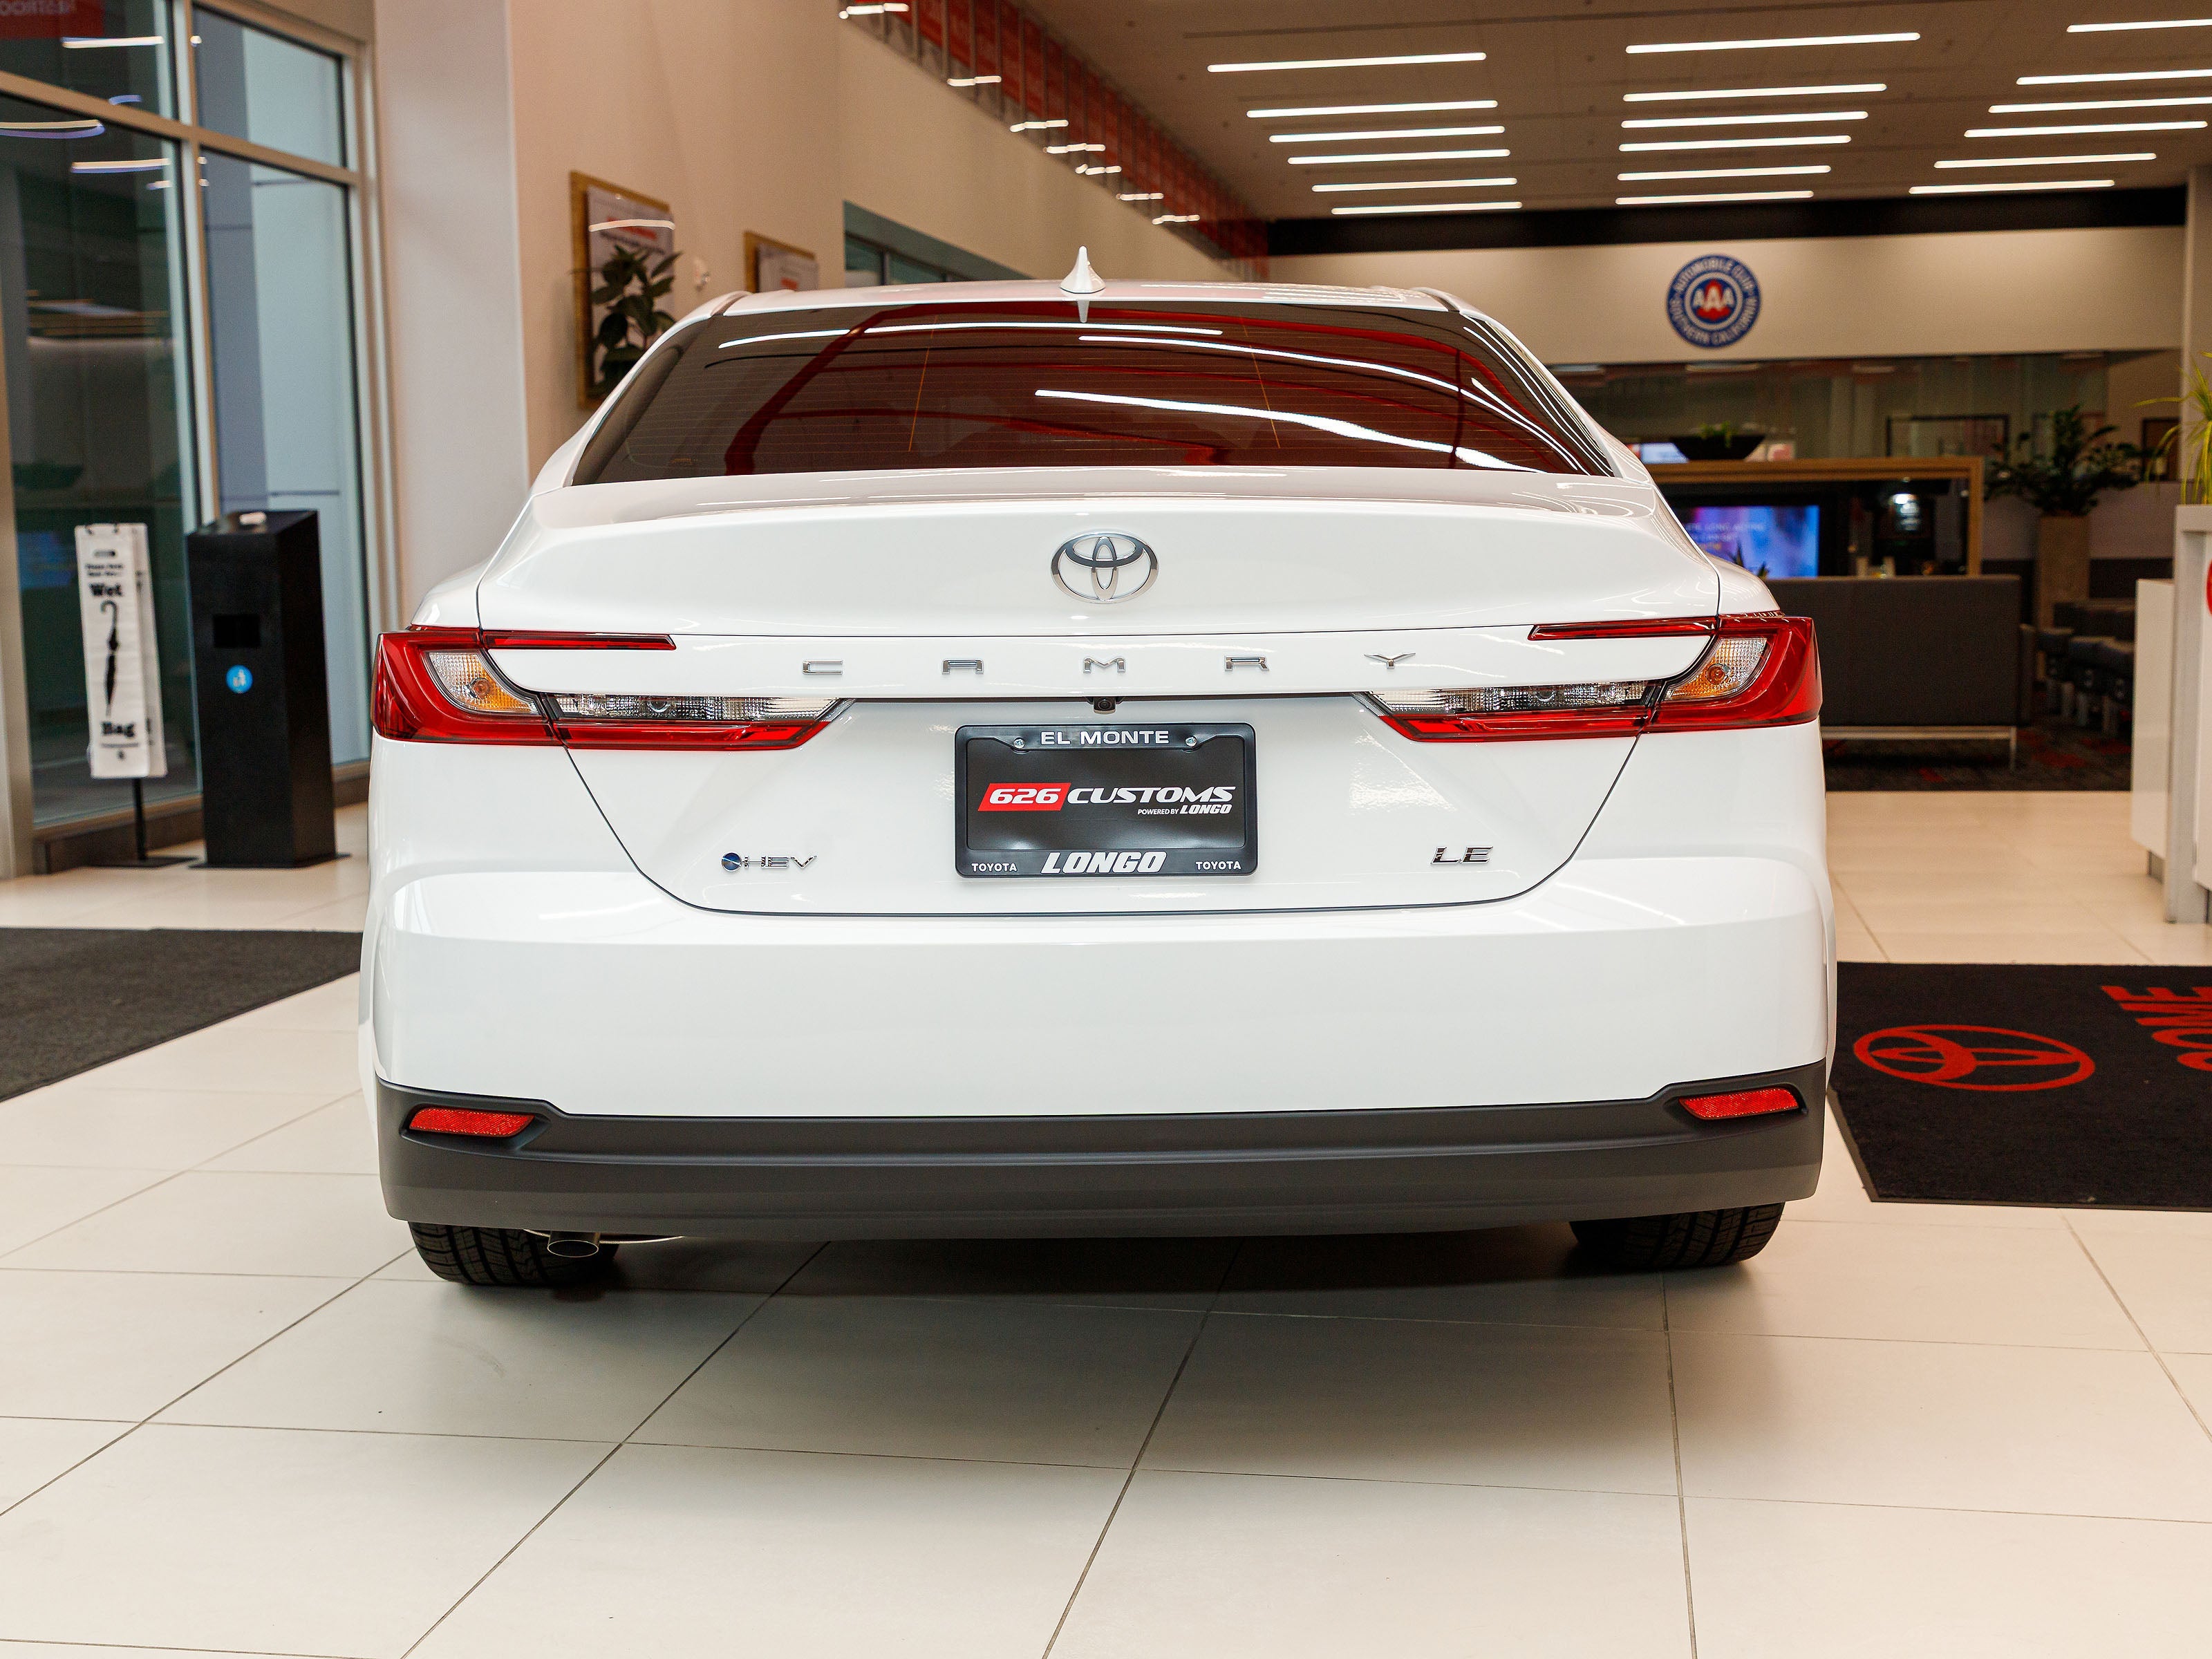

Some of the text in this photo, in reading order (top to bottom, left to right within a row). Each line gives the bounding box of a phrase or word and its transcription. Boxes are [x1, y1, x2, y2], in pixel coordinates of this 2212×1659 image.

[1694, 285, 1735, 311] AAA
[88, 582, 123, 597] Wet
[802, 653, 1416, 675] CAMRY
[101, 721, 135, 738] Bag
[1041, 730, 1170, 745] EL MONTE
[988, 786, 1237, 805] 626 CUSTOMS
[1179, 803, 1233, 815] LONGO
[971, 850, 1242, 874] TOYOTA LONGO TOYOTA
[1430, 845, 1494, 865] LE
